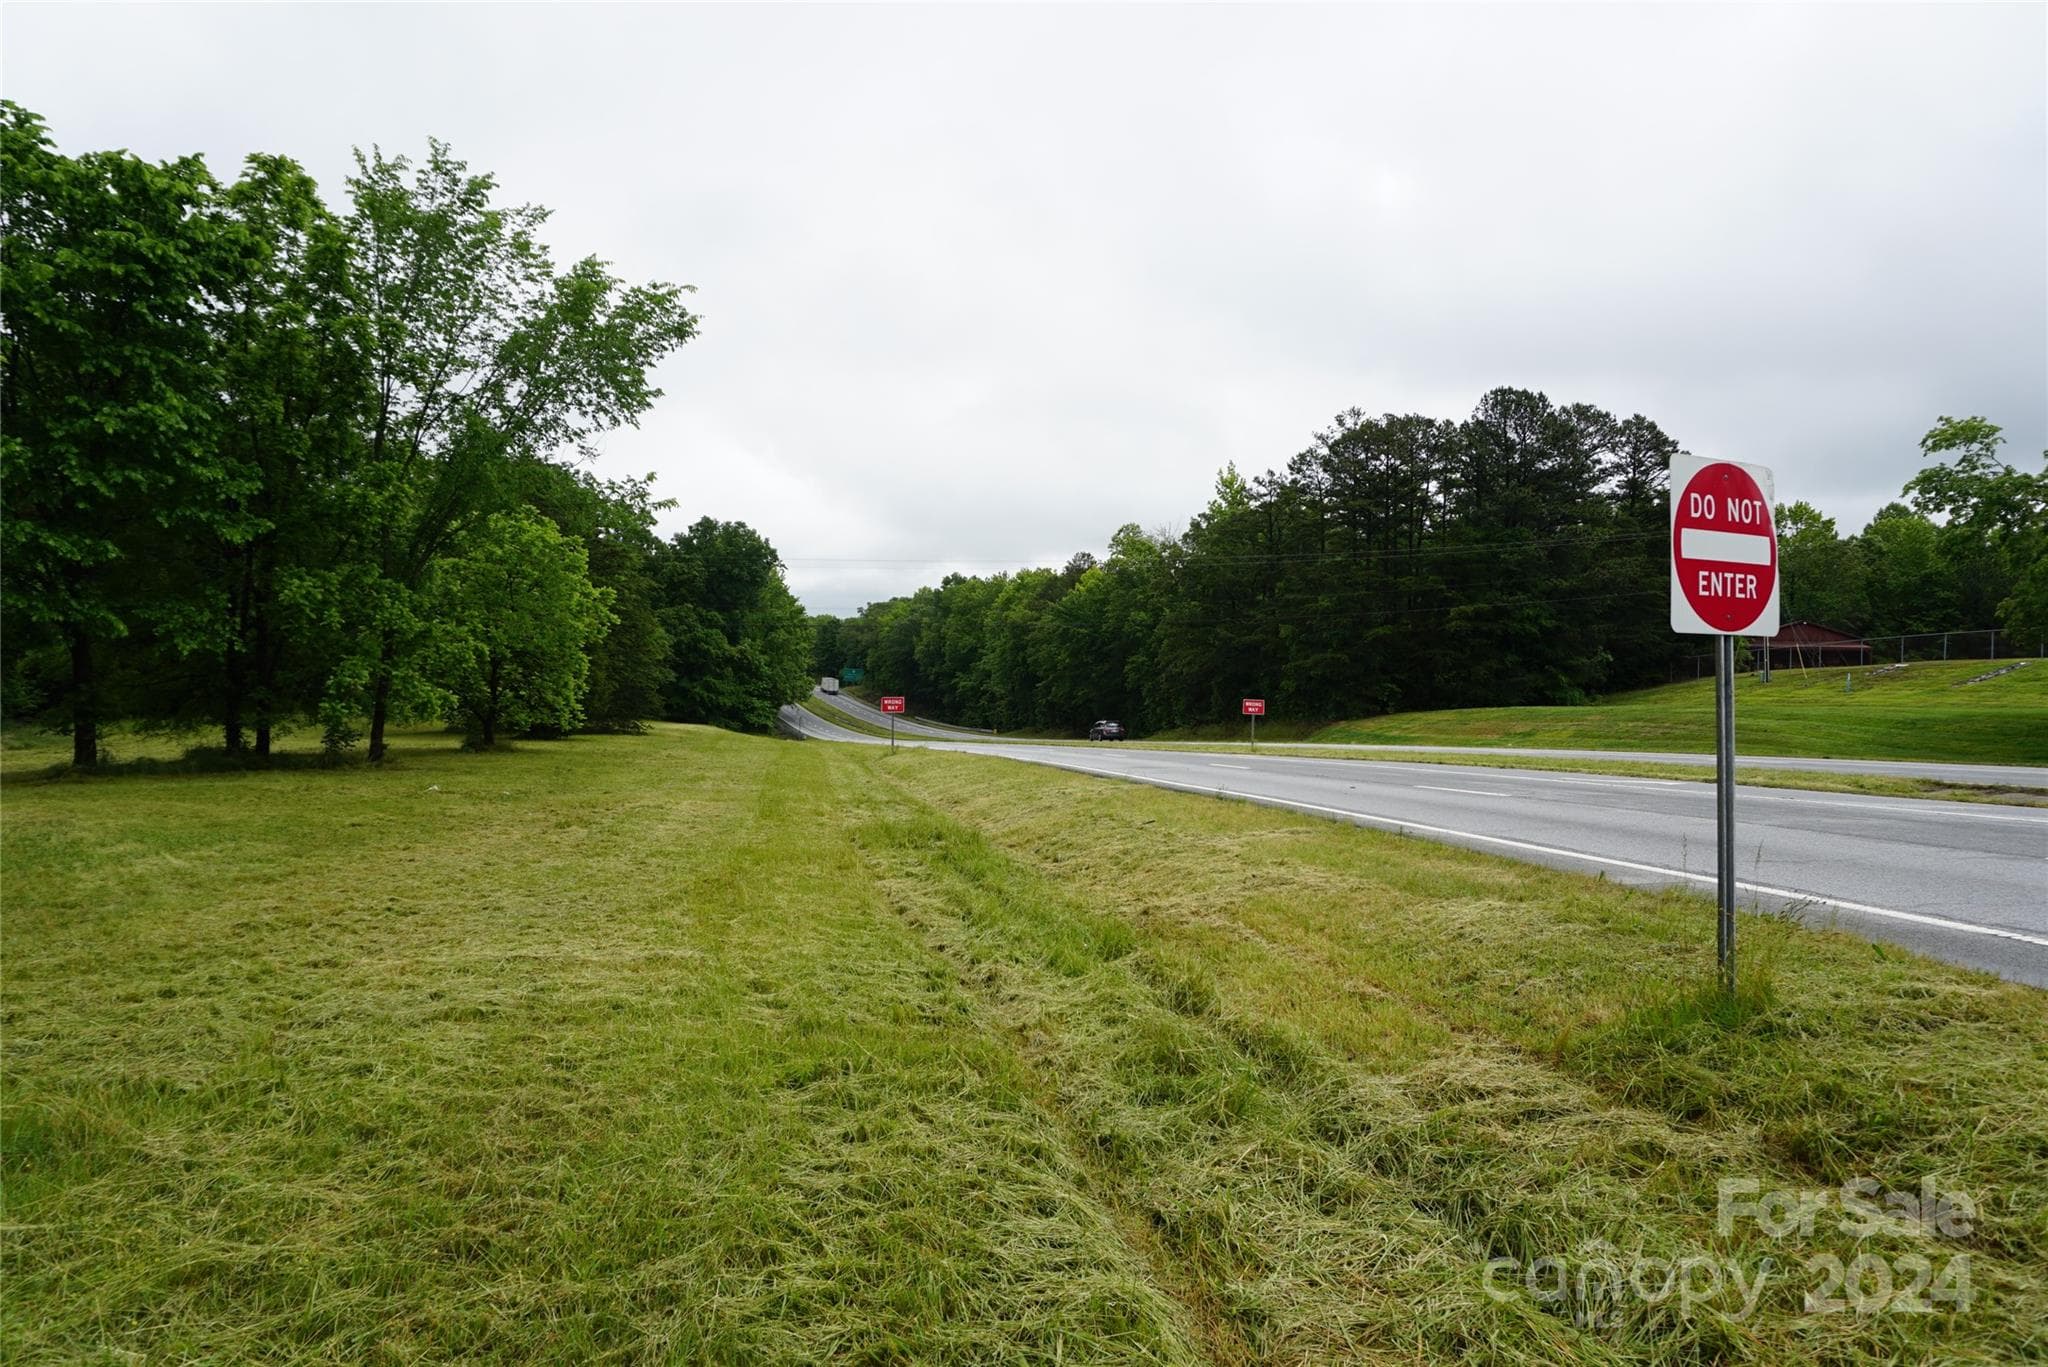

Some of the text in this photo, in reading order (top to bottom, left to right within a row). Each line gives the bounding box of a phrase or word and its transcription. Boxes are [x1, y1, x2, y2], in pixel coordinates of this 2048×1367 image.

[1690, 492, 1762, 525] DO NOT
[1698, 570, 1758, 600] ENTER
